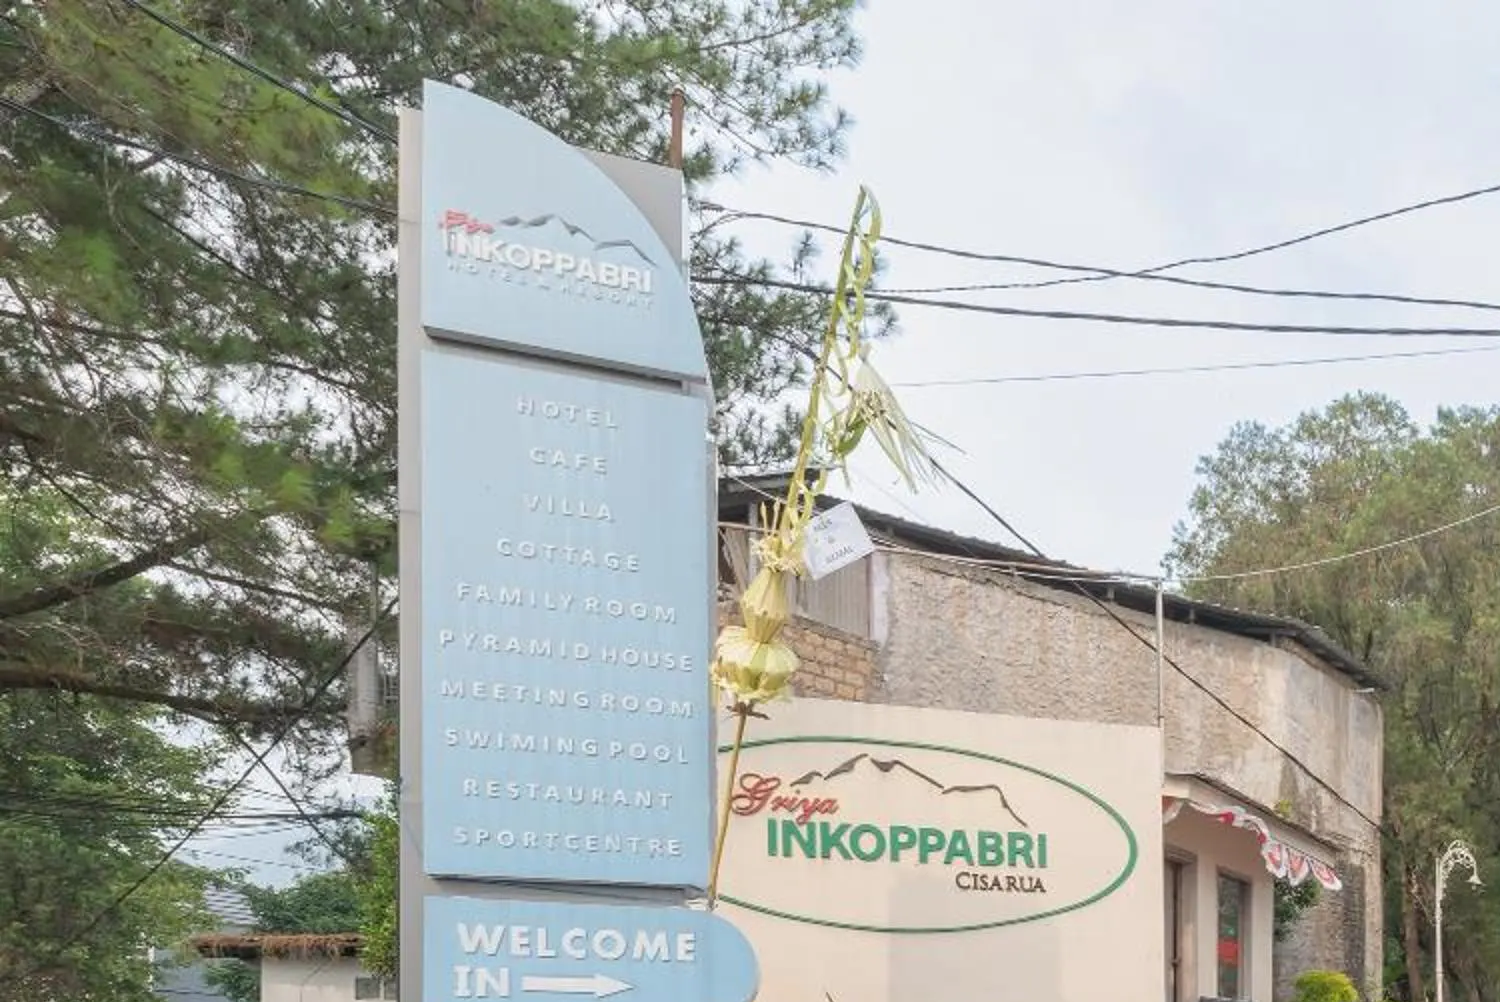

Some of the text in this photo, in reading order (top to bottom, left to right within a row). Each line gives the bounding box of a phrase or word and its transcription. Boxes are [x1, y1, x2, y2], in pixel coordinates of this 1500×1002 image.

[442, 226, 656, 293] INKOPPABRI
[517, 397, 618, 428] HOTEL
[530, 447, 608, 476] CAFE
[525, 494, 616, 523] VILLA
[497, 538, 641, 573] COTTAGE
[457, 582, 678, 624] FAMILY ROOM
[440, 629, 694, 672] PYRAMID HOUSE
[440, 679, 694, 718] MEETING ROOM
[444, 728, 690, 764] SWIMING POOL
[463, 778, 674, 809] RESTAURANT
[731, 772, 839, 824] Griya
[767, 817, 1048, 869] INKOPPABRI
[955, 870, 1047, 894] CISARUA
[456, 922, 698, 962] WELCOME
[453, 965, 511, 998] IN
